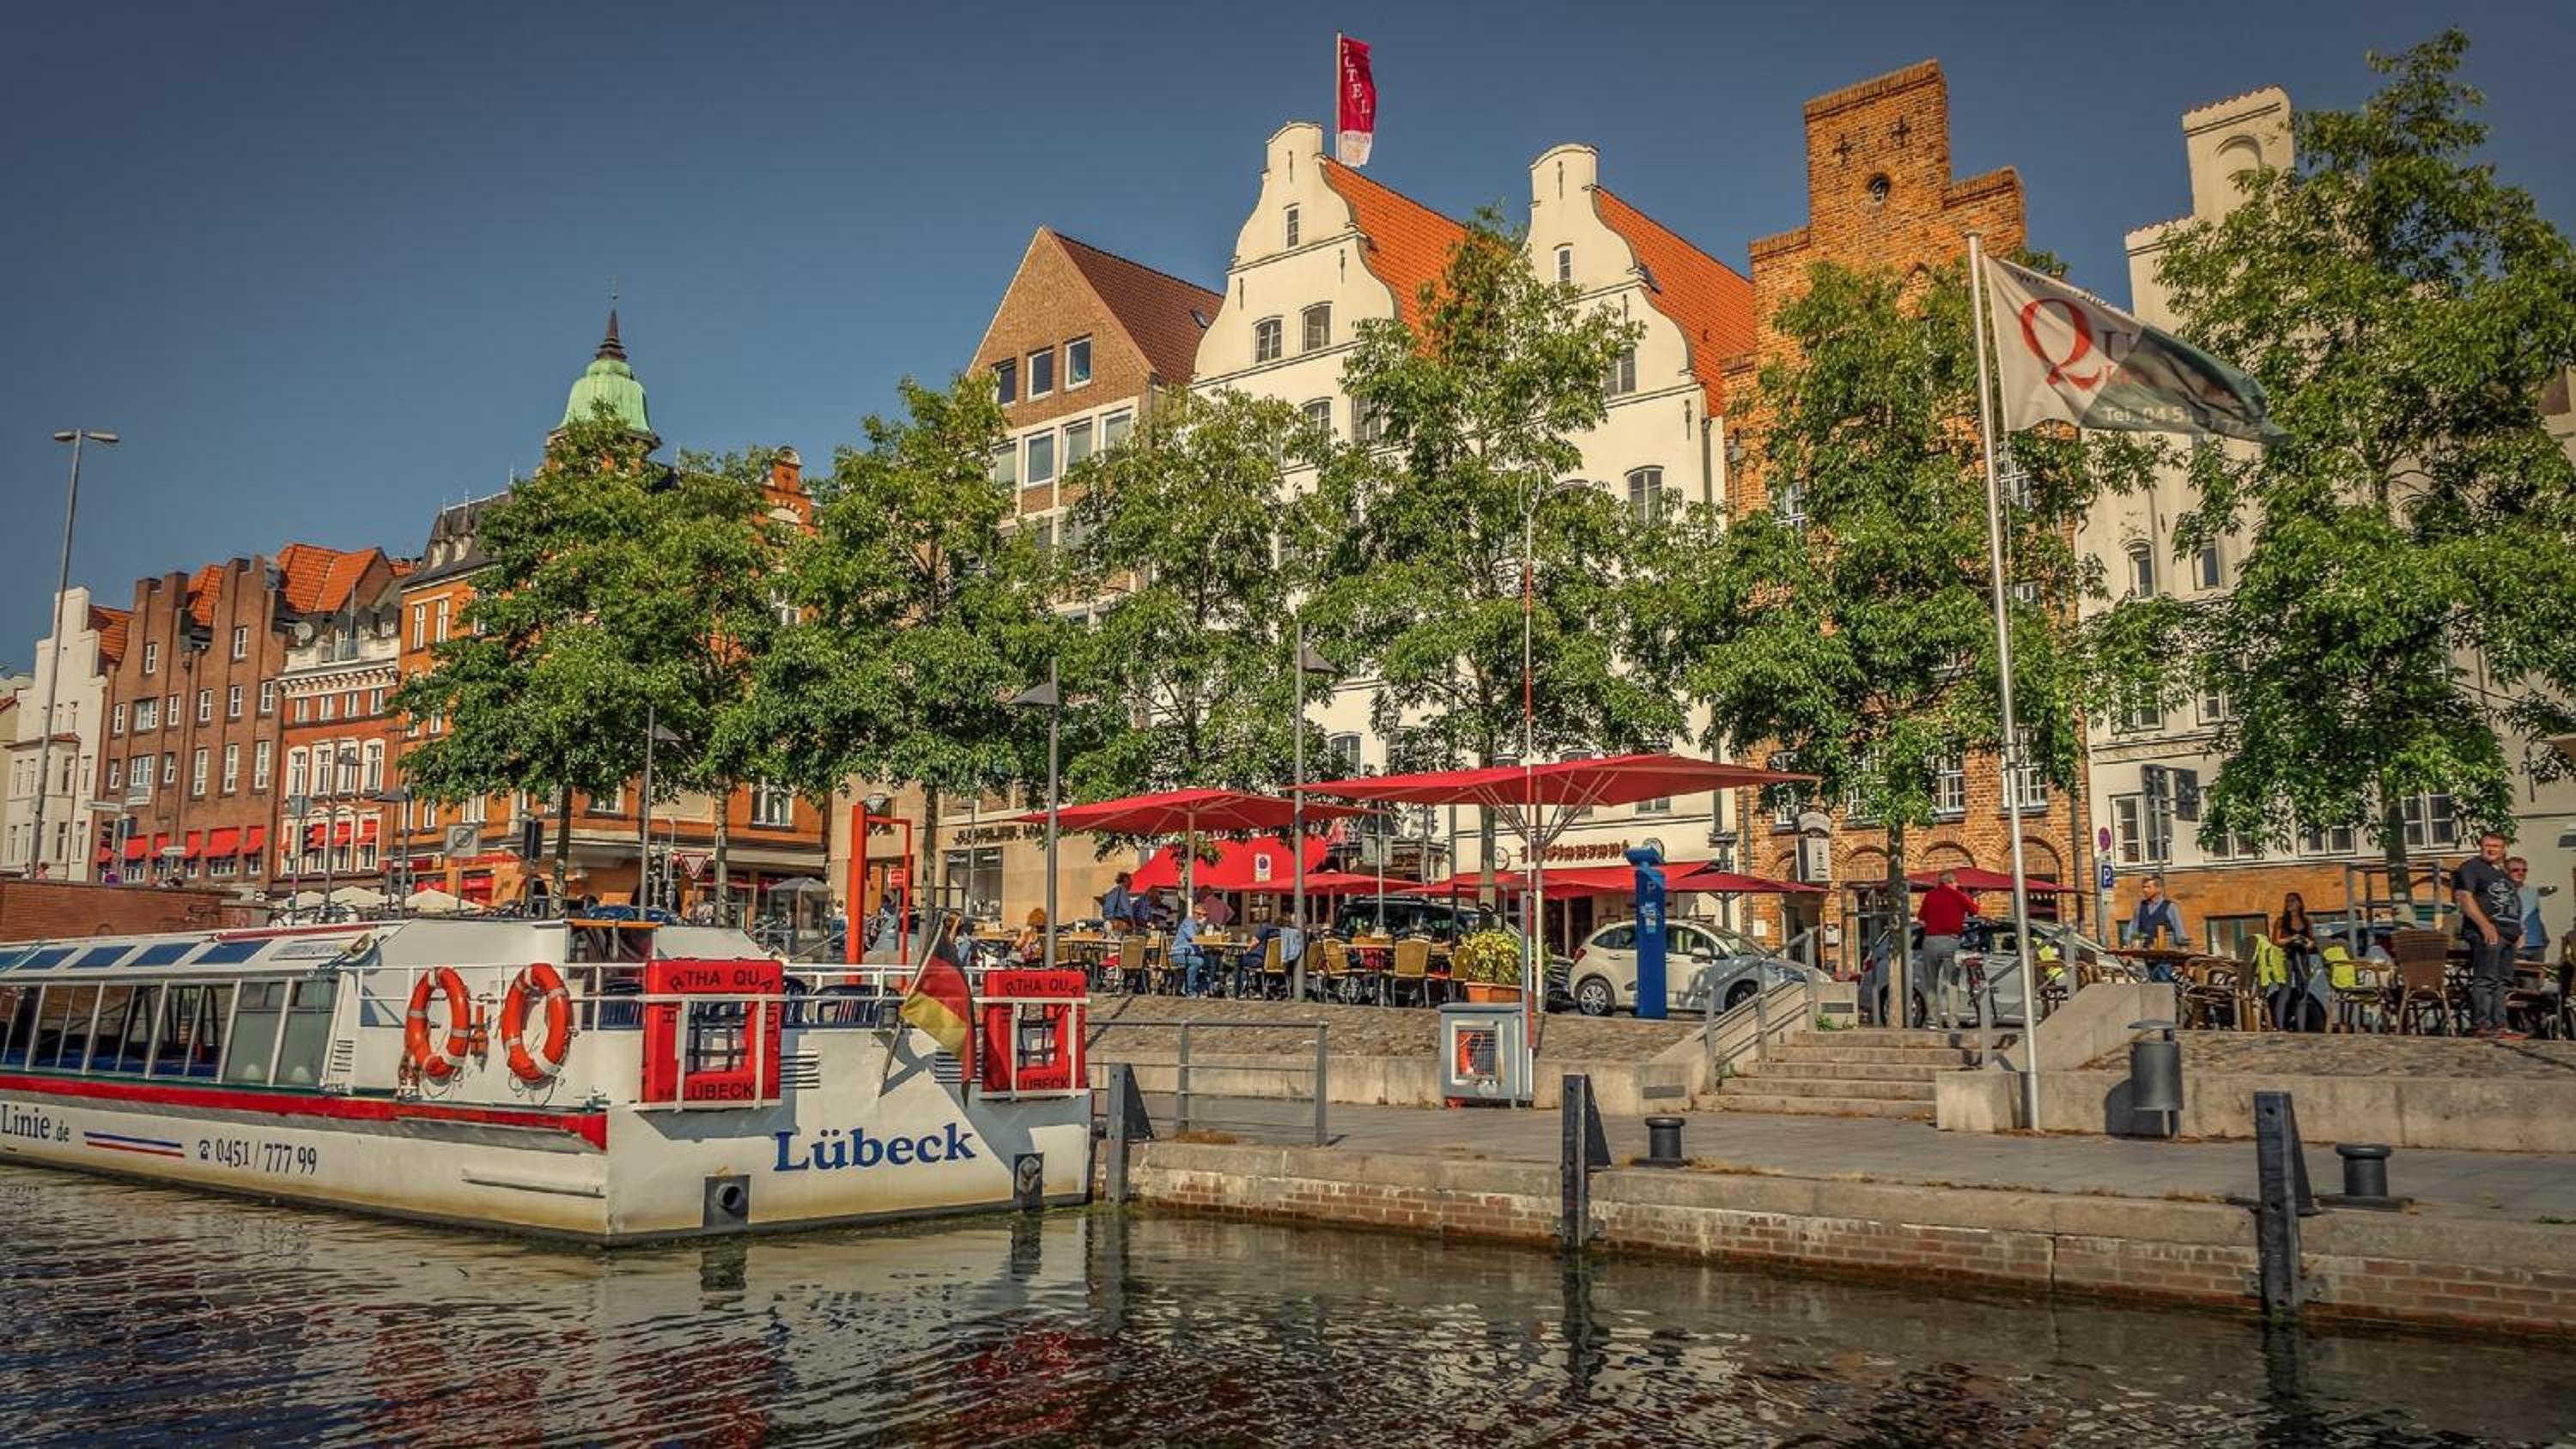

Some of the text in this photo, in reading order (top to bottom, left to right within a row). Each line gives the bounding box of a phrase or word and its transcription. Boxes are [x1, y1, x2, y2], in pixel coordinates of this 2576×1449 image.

[690, 1081, 756, 1100] ÜBECK
[264, 1143, 293, 1173] 777
[298, 1147, 317, 1175] 99
[774, 1123, 977, 1172] Lübeck
